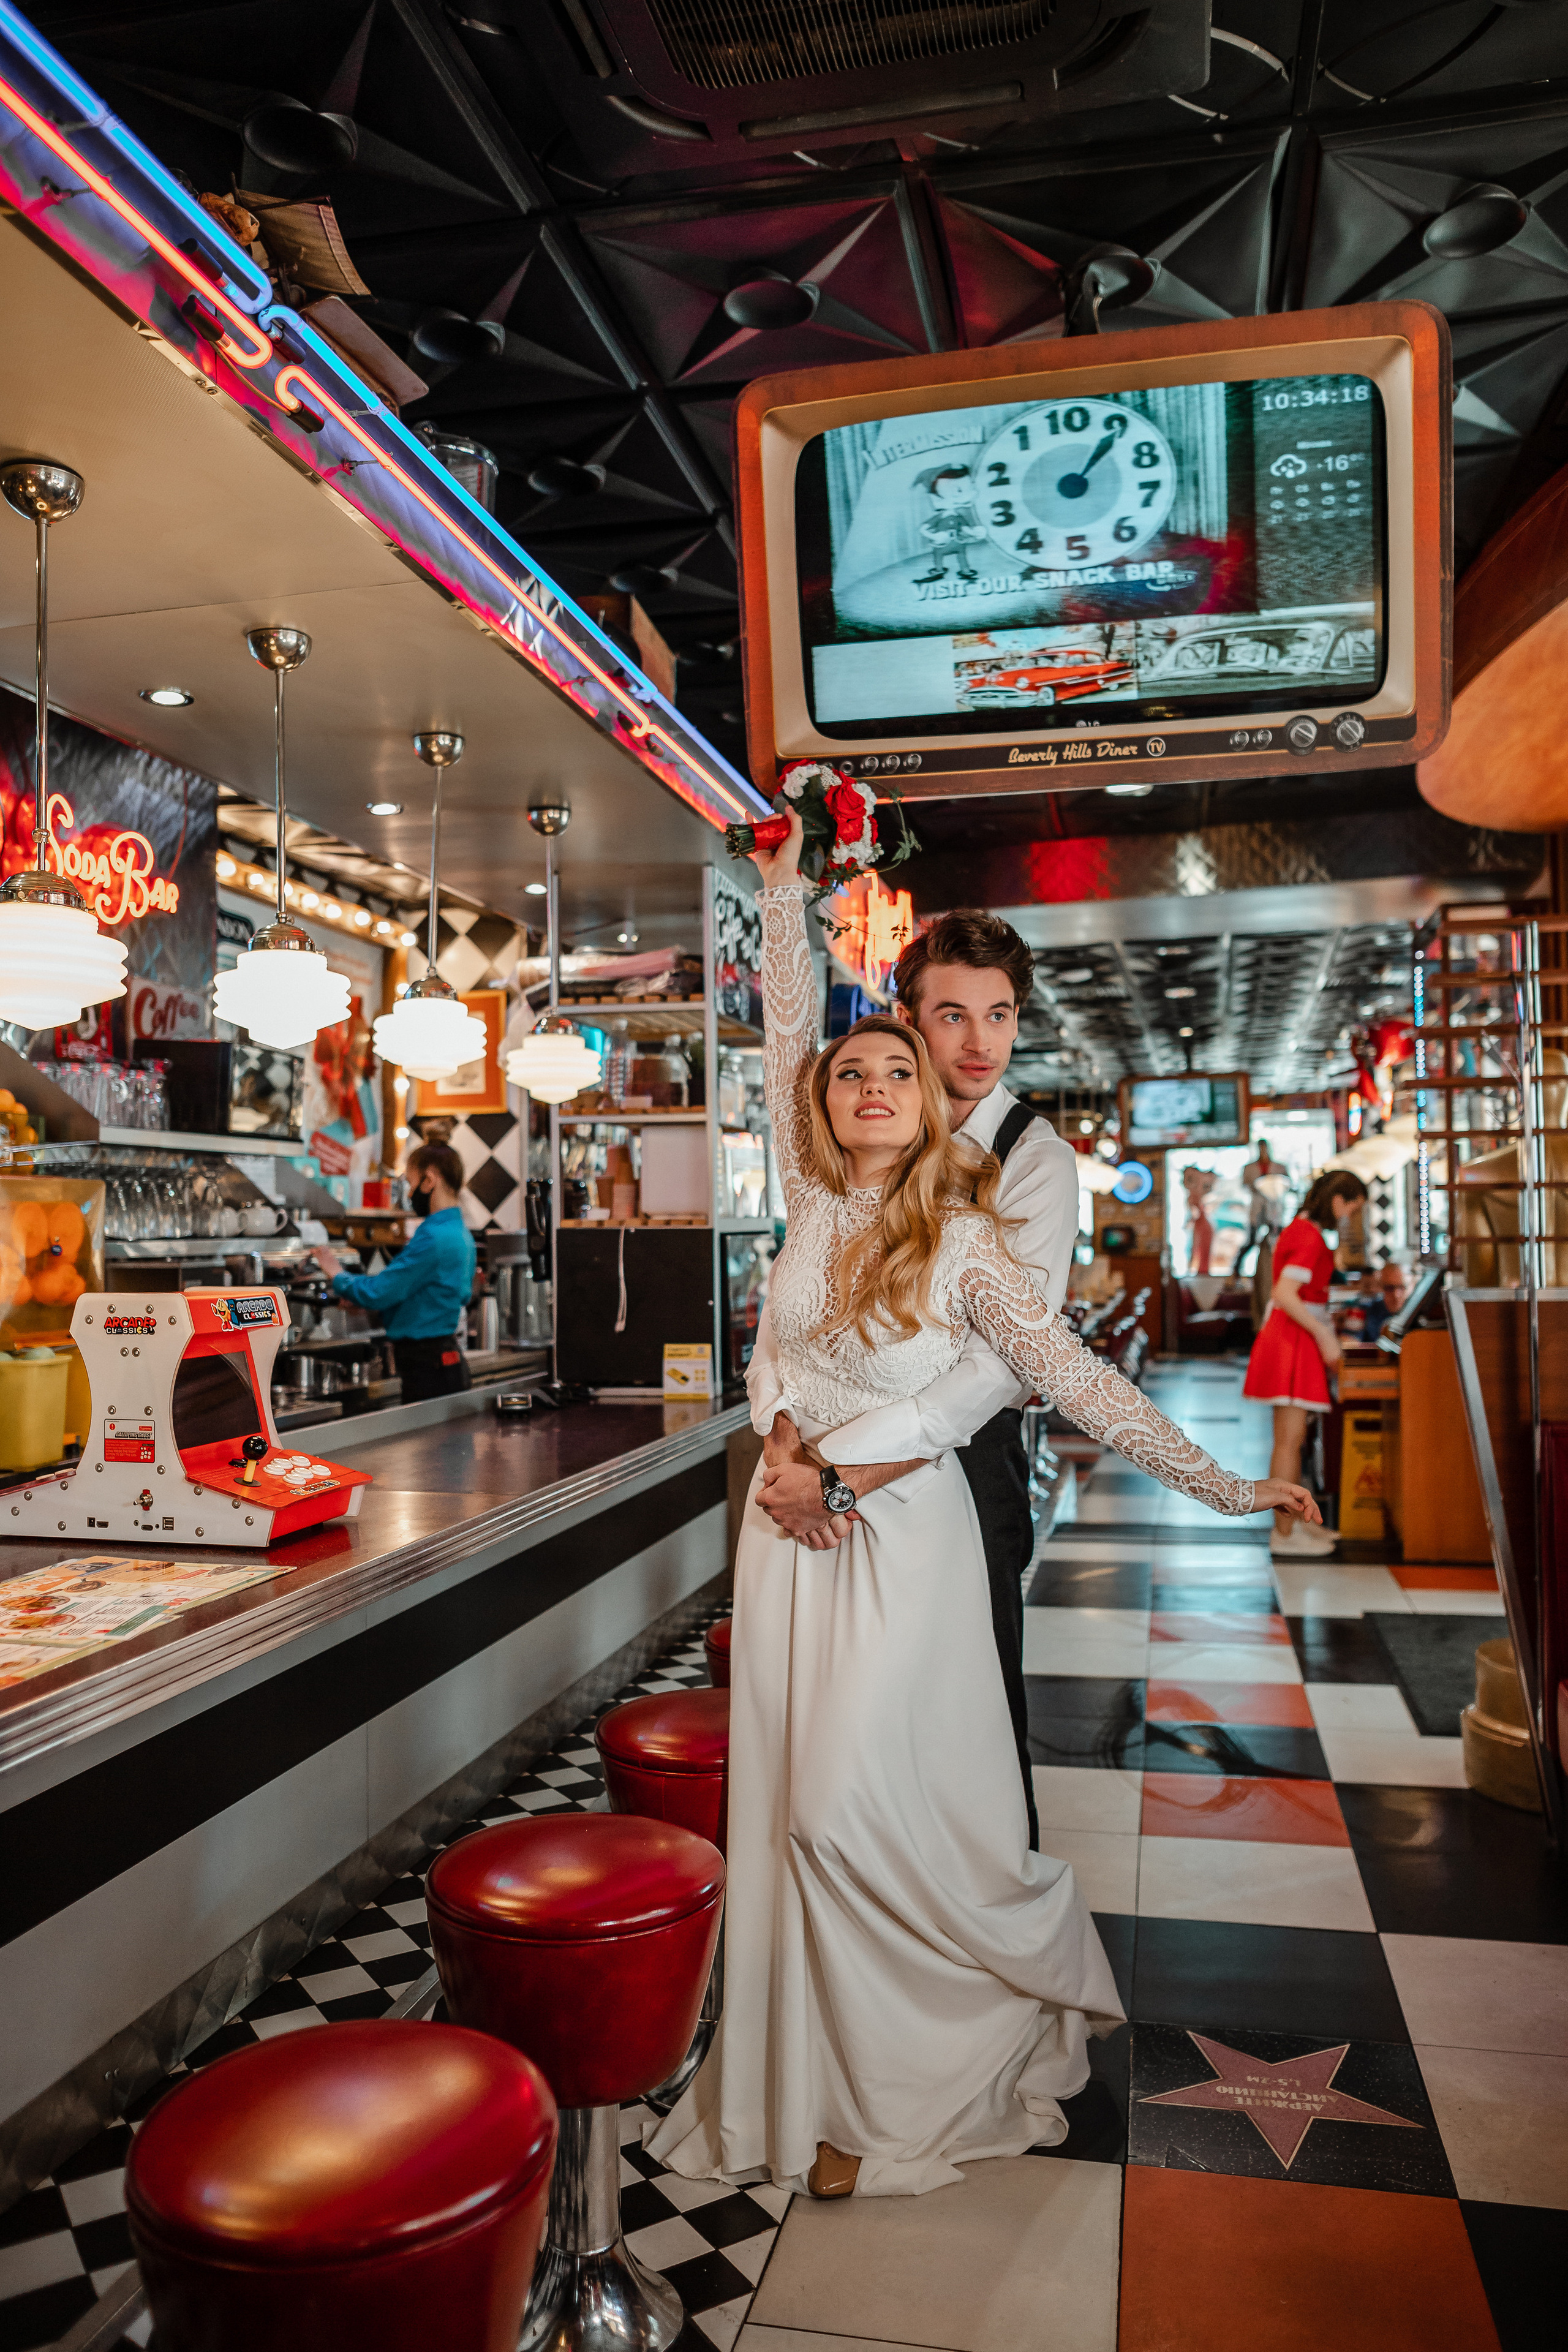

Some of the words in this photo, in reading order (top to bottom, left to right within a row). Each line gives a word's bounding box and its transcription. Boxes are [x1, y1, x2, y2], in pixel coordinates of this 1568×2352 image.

[1262, 385, 1369, 411] 10:34:18
[1044, 406, 1090, 435] 10
[1012, 426, 1030, 451] 1
[1132, 442, 1160, 469] 8
[987, 462, 1010, 487] 2
[1138, 480, 1161, 508] 7
[990, 500, 1016, 527] 3
[1015, 527, 1044, 555] 4
[1113, 516, 1137, 543] 6
[1066, 535, 1090, 561] 5
[917, 582, 967, 601] VISIT
[979, 576, 1025, 595] OUR
[1034, 565, 1116, 589] SNACK
[1125, 560, 1175, 582] BAR
[1008, 745, 1058, 766] Beverly
[1062, 742, 1091, 760] Hills
[1096, 742, 1138, 758] Diner
[1149, 742, 1163, 753] TV
[134, 986, 200, 1039] Coffee
[236, 1299, 273, 1313] ARCADE
[104, 1317, 151, 1329] ARCADE
